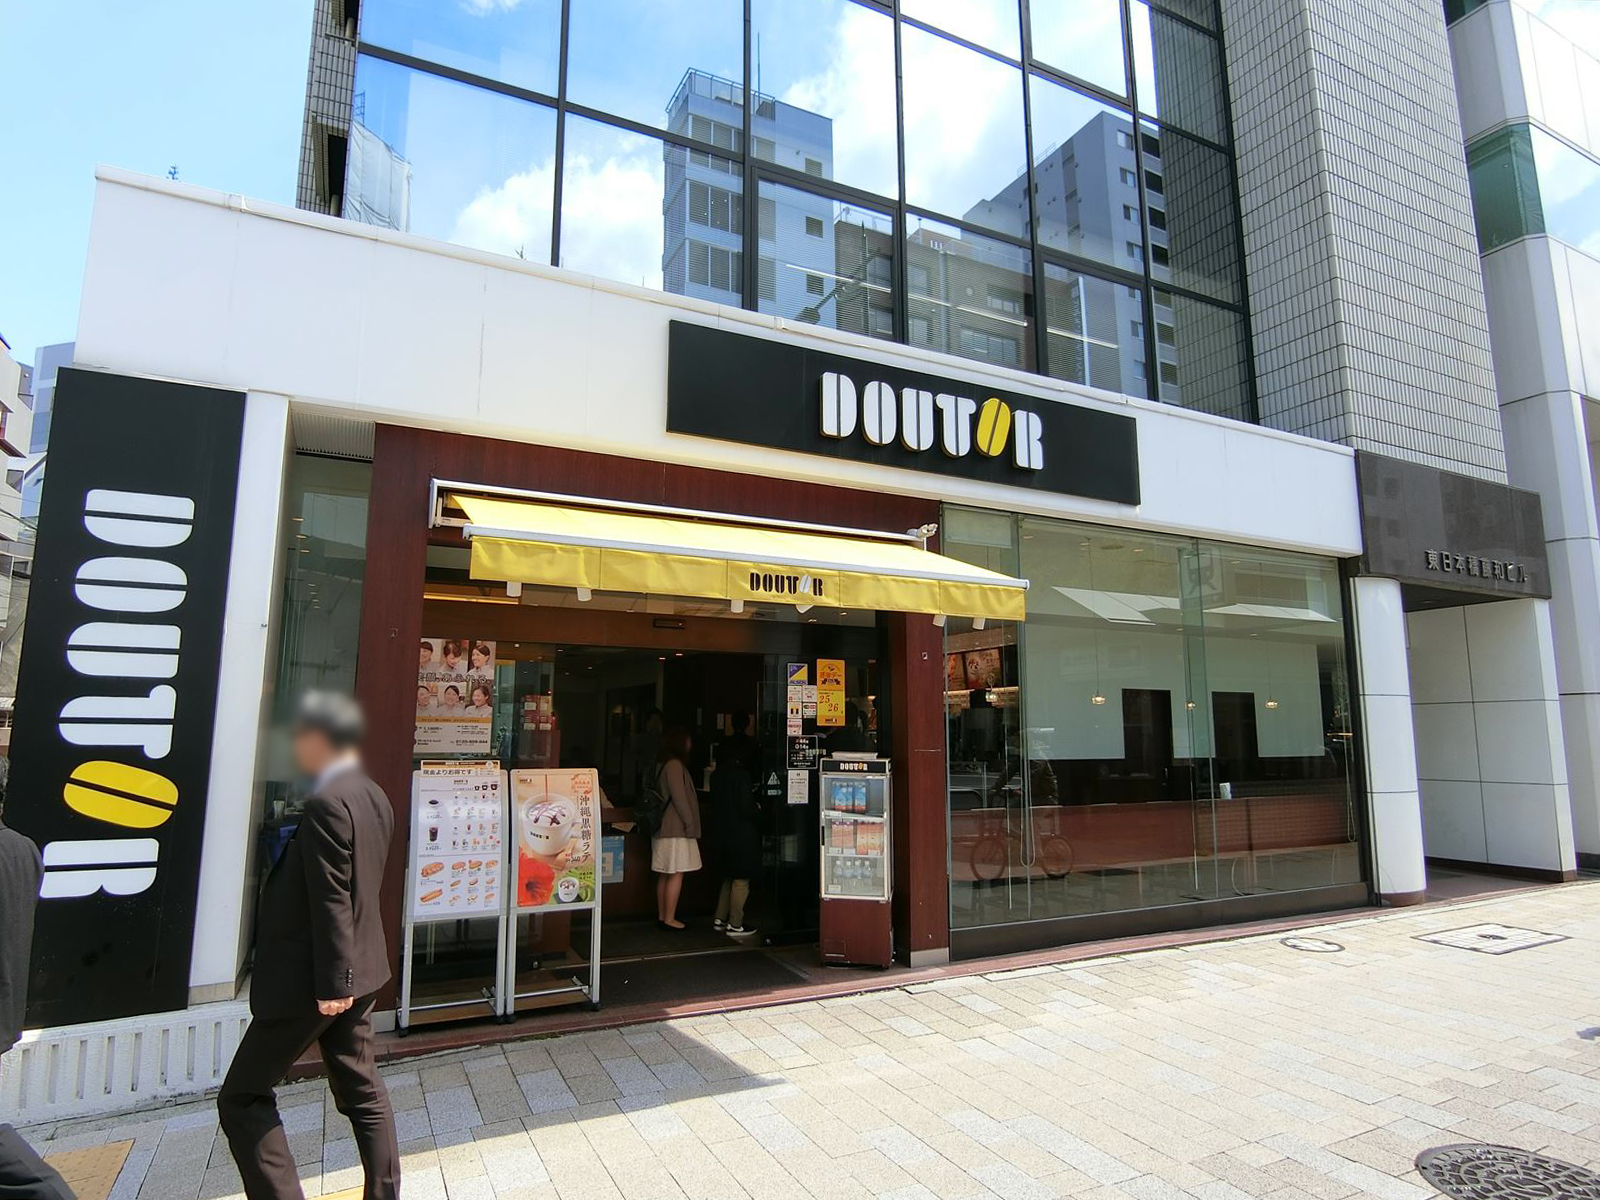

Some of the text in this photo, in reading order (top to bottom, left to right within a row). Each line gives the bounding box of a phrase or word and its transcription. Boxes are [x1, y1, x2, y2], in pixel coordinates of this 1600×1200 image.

[820, 371, 1044, 470] DOUTOR
[750, 572, 823, 597] DOUTOR
[39, 489, 195, 899] DOUTOR
[819, 694, 830, 704] 25
[828, 703, 839, 712] 26
[840, 763, 868, 771] DOUTOR
[579, 795, 592, 864] 沖縄黒糖ラテ
